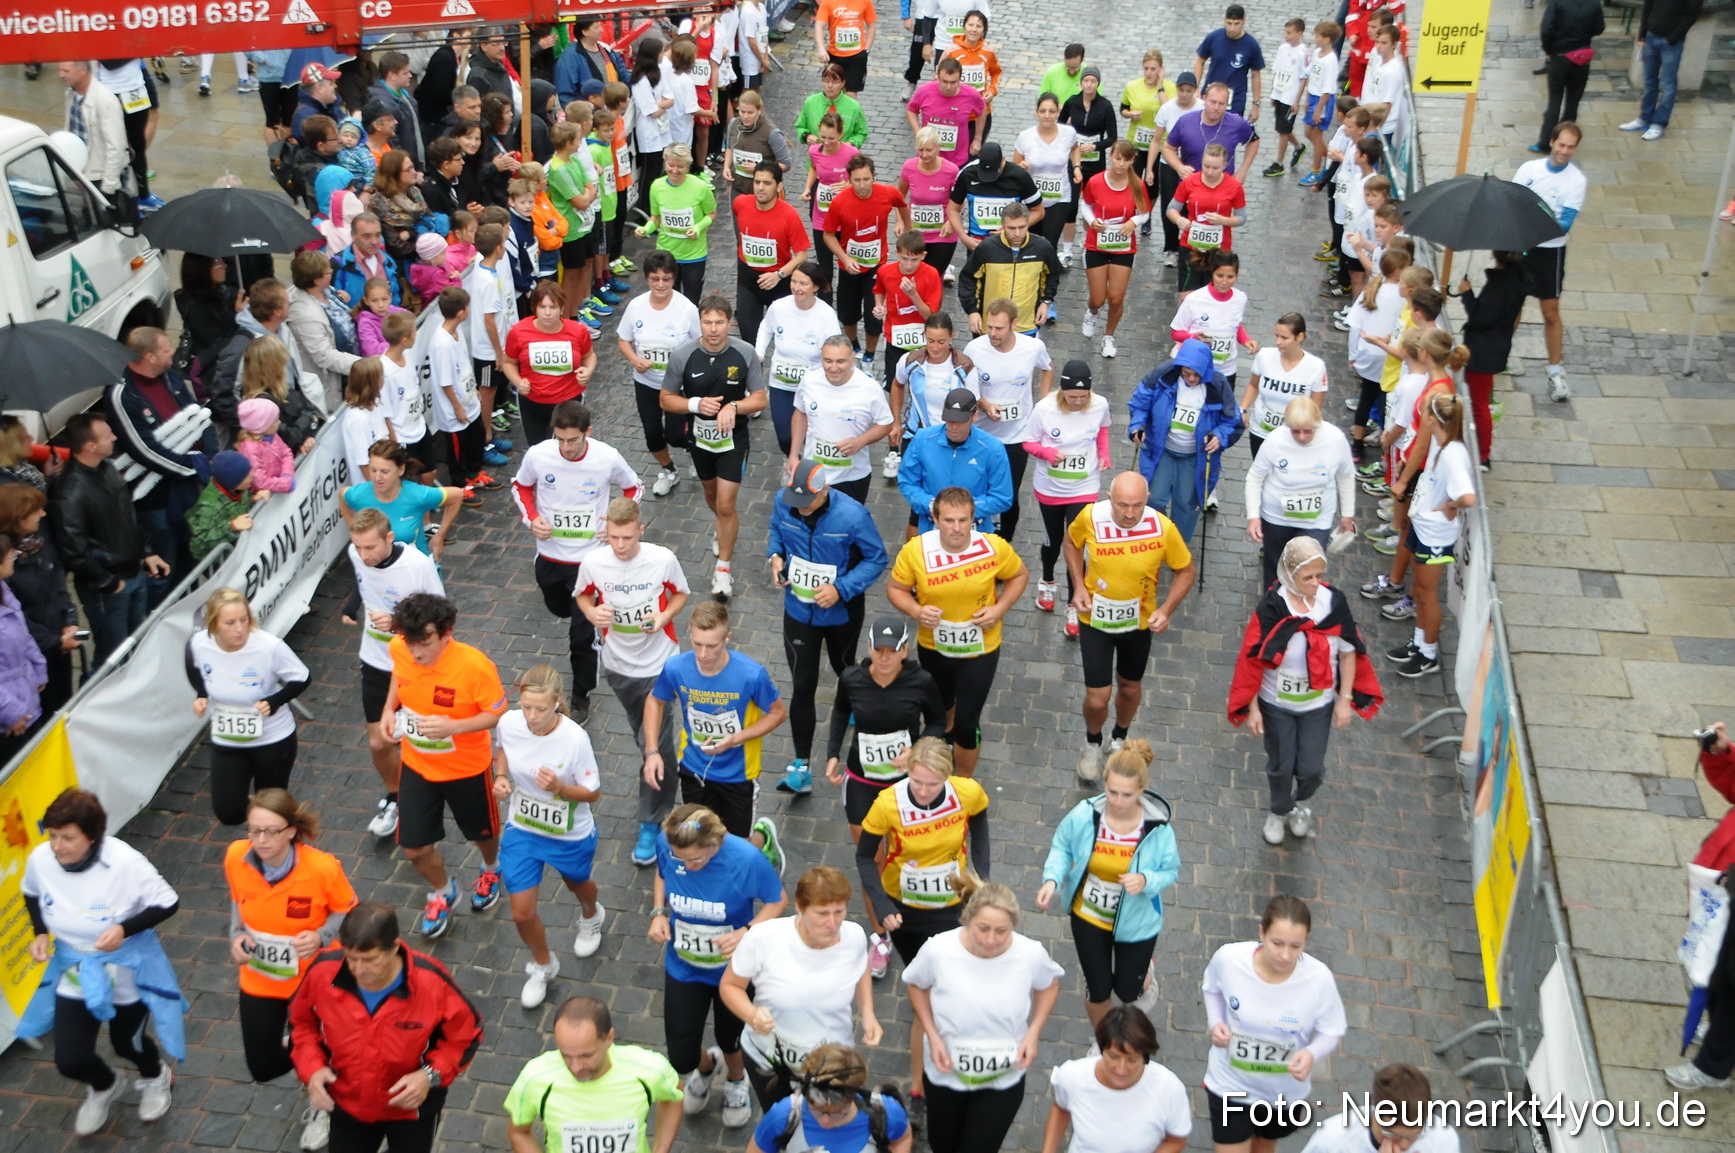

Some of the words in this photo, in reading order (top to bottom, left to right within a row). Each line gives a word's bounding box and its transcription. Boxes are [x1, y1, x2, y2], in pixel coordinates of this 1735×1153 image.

[0, 8, 116, 35] viceline:
[122, 3, 198, 29] 09181
[205, 1, 271, 24] 6352
[948, 18, 966, 27] 516
[1422, 22, 1484, 39] Jugend-
[1436, 40, 1466, 56] lauf
[692, 66, 709, 75] 050
[1136, 132, 1154, 144] 513
[1035, 180, 1061, 192] 5030
[914, 211, 941, 223] 5028
[977, 206, 1003, 218] 5140
[665, 216, 691, 227] 5002
[1192, 229, 1219, 243] 5063
[745, 242, 773, 257] 5060
[850, 247, 878, 259] 5062
[896, 331, 926, 346] 5061
[1210, 339, 1232, 352] 024
[534, 349, 568, 365] 5058
[1263, 375, 1307, 395] THULE
[1172, 407, 1196, 424] 176
[1051, 456, 1086, 470] 149
[1286, 497, 1322, 511] 5178
[554, 514, 592, 528] 5137
[1096, 547, 1125, 556] MAX
[1130, 541, 1164, 554] BÖGL
[245, 514, 297, 601] BMW
[927, 572, 959, 587] MAX
[964, 560, 998, 578] BÖGL
[1096, 605, 1135, 621] 5129
[938, 628, 978, 644] 5142
[689, 688, 740, 700] NEUMARKTER
[1282, 679, 1312, 693] 517
[217, 715, 257, 735] 5155
[693, 719, 736, 735] 5015
[520, 797, 563, 826] 5016
[903, 825, 930, 838] MAX
[934, 813, 964, 831] BÖGL
[669, 892, 727, 914] HUBER
[1088, 885, 1121, 910] 512
[681, 933, 715, 953] 511
[257, 945, 292, 965] 084
[1236, 1040, 1290, 1062] 5127
[958, 1054, 1011, 1073] 5044
[570, 1132, 631, 1153] 5097
